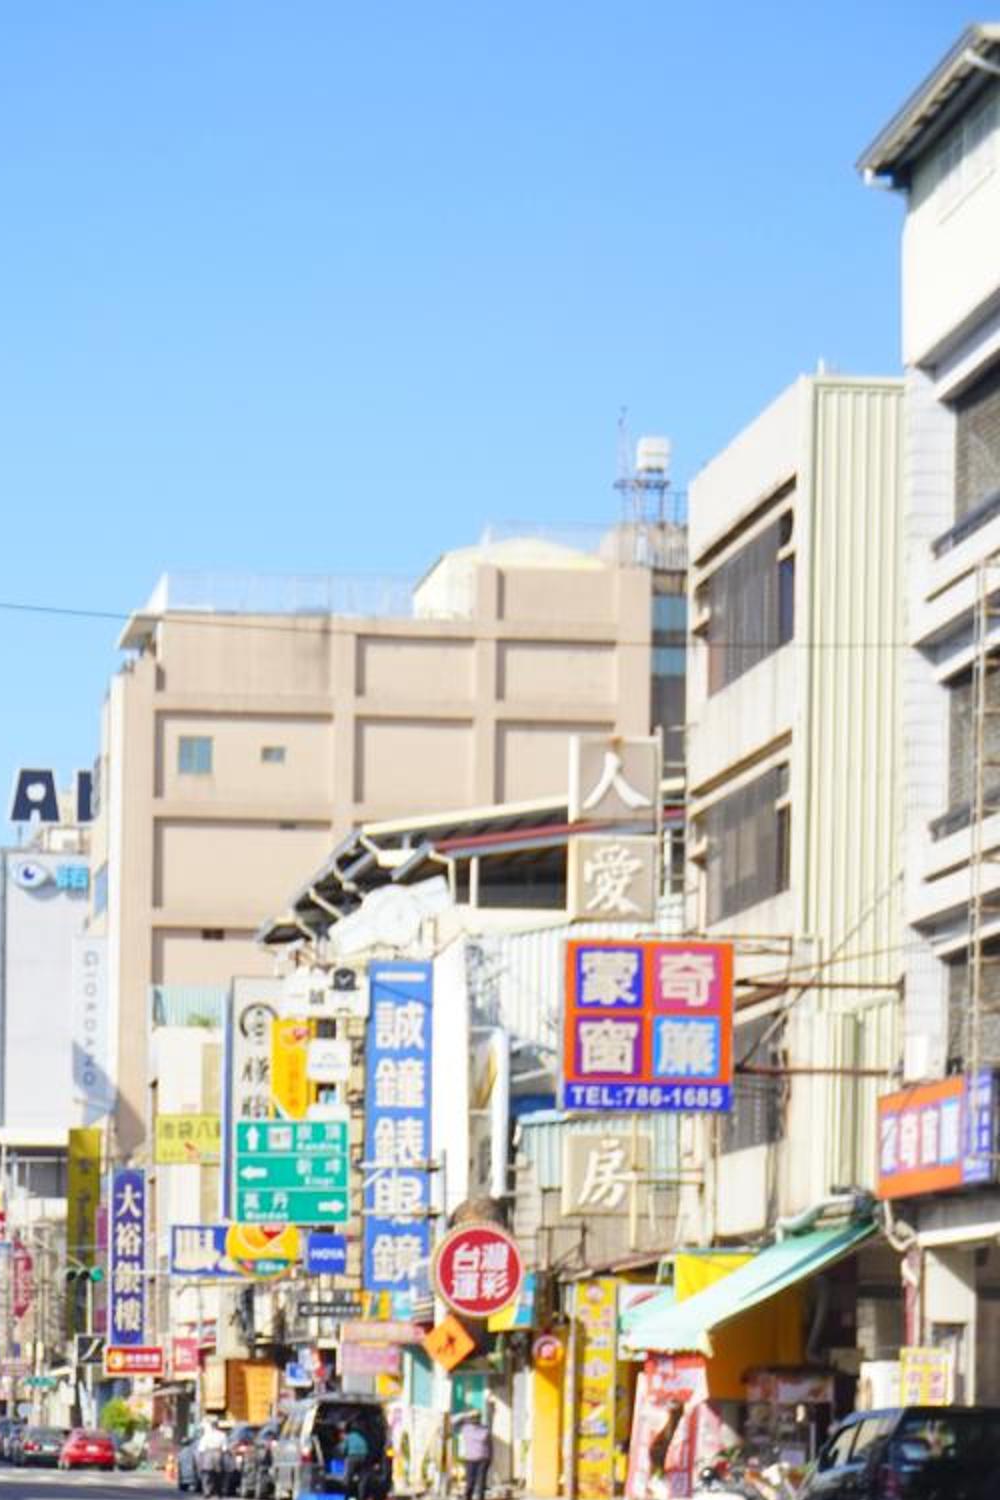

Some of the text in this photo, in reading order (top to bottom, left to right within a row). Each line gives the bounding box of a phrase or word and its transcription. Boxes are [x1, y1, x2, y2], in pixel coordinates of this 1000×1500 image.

[581, 951, 715, 1007] 蒙奇
[83, 949, 99, 1086] GIORDANO
[578, 1019, 717, 1075] 窗簾
[571, 1086, 723, 1108] TEL:786-1685
[310, 1248, 345, 1260] HOYA
[453, 1241, 510, 1270] 台灣
[451, 1270, 510, 1300] 運彩
